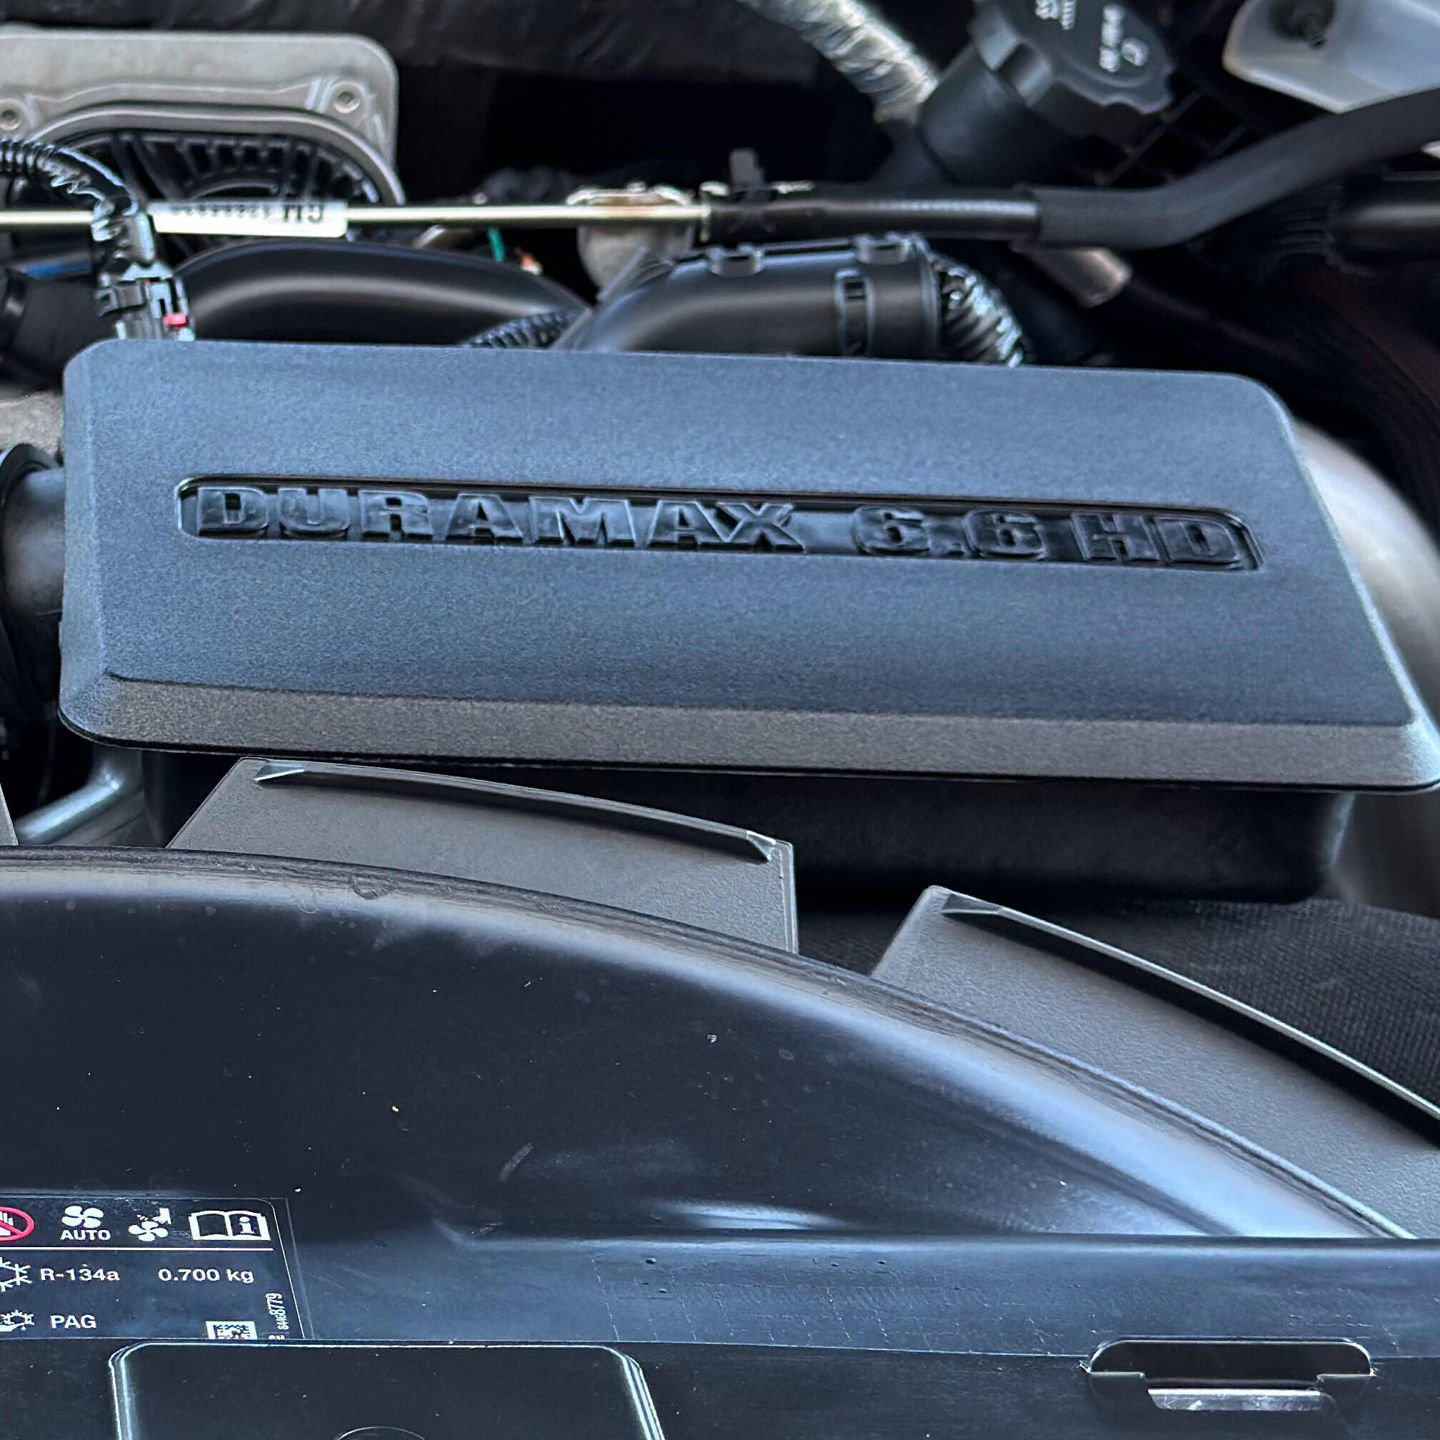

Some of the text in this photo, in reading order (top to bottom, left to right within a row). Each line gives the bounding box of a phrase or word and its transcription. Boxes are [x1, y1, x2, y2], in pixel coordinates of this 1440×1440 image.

[198, 486, 1241, 569] DURAMAX 6.6 HD
[60, 1229, 112, 1242] AUTO
[39, 1266, 255, 1285] R-134a 0.700 kg
[50, 1314, 97, 1330] PAG
